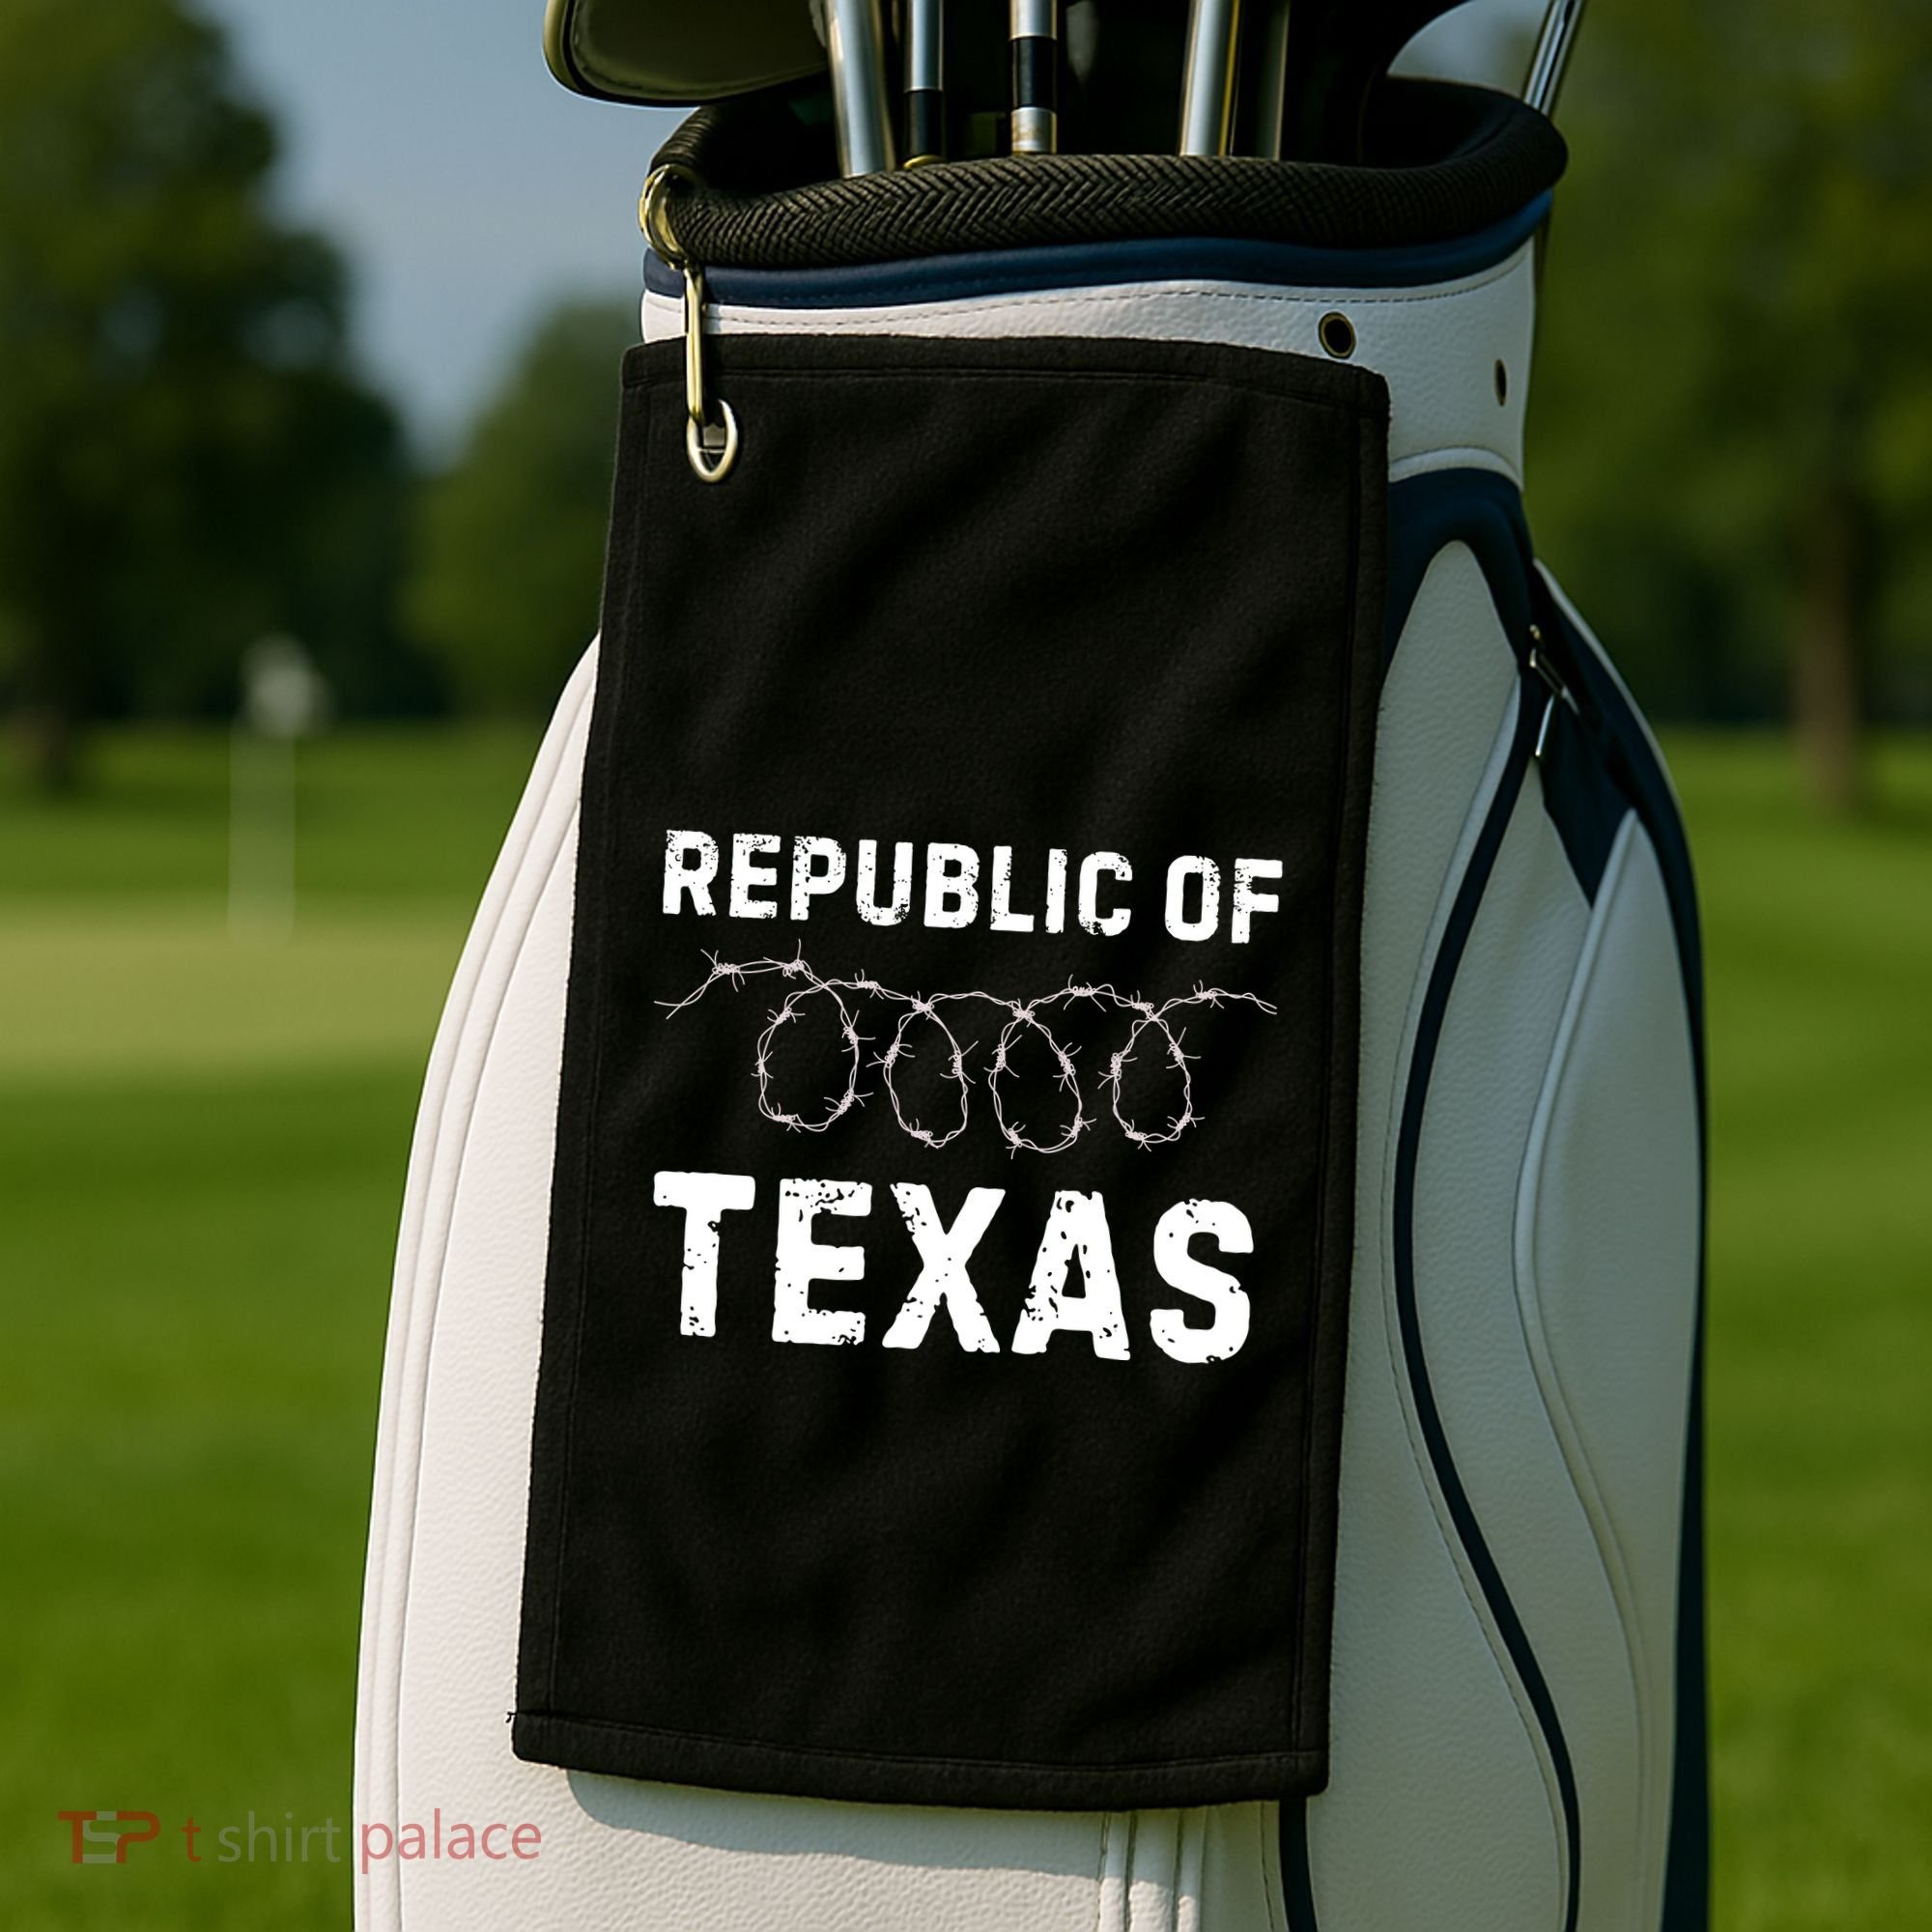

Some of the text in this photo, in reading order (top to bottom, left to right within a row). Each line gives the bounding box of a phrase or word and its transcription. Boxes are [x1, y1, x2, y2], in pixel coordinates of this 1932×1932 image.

[662, 829, 1284, 944] REPUBLIC OF
[653, 1170, 1255, 1364] TEXAS
